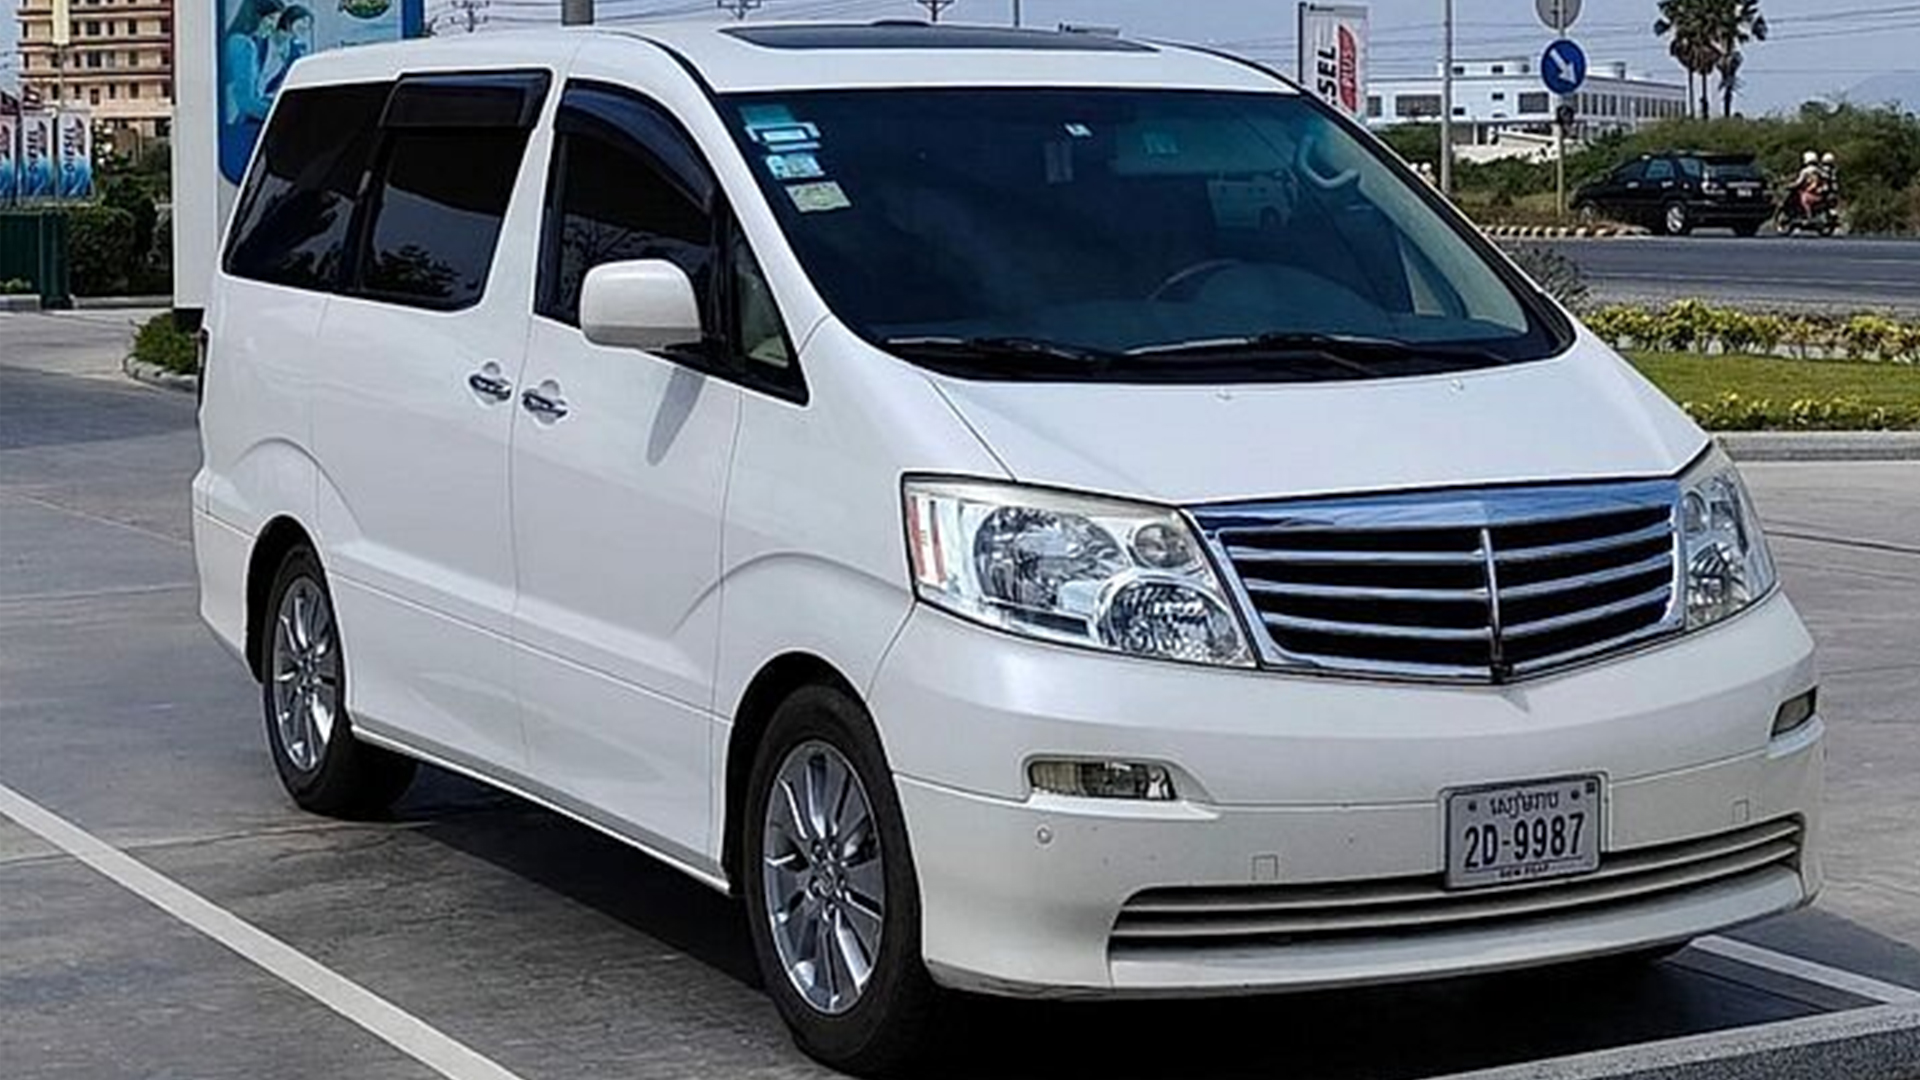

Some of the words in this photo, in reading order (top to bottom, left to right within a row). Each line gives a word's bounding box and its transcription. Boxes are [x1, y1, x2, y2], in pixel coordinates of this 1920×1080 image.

[1317, 46, 1336, 106] SEL
[1340, 51, 1354, 89] PLUS
[1464, 812, 1584, 868] 2D-9987
